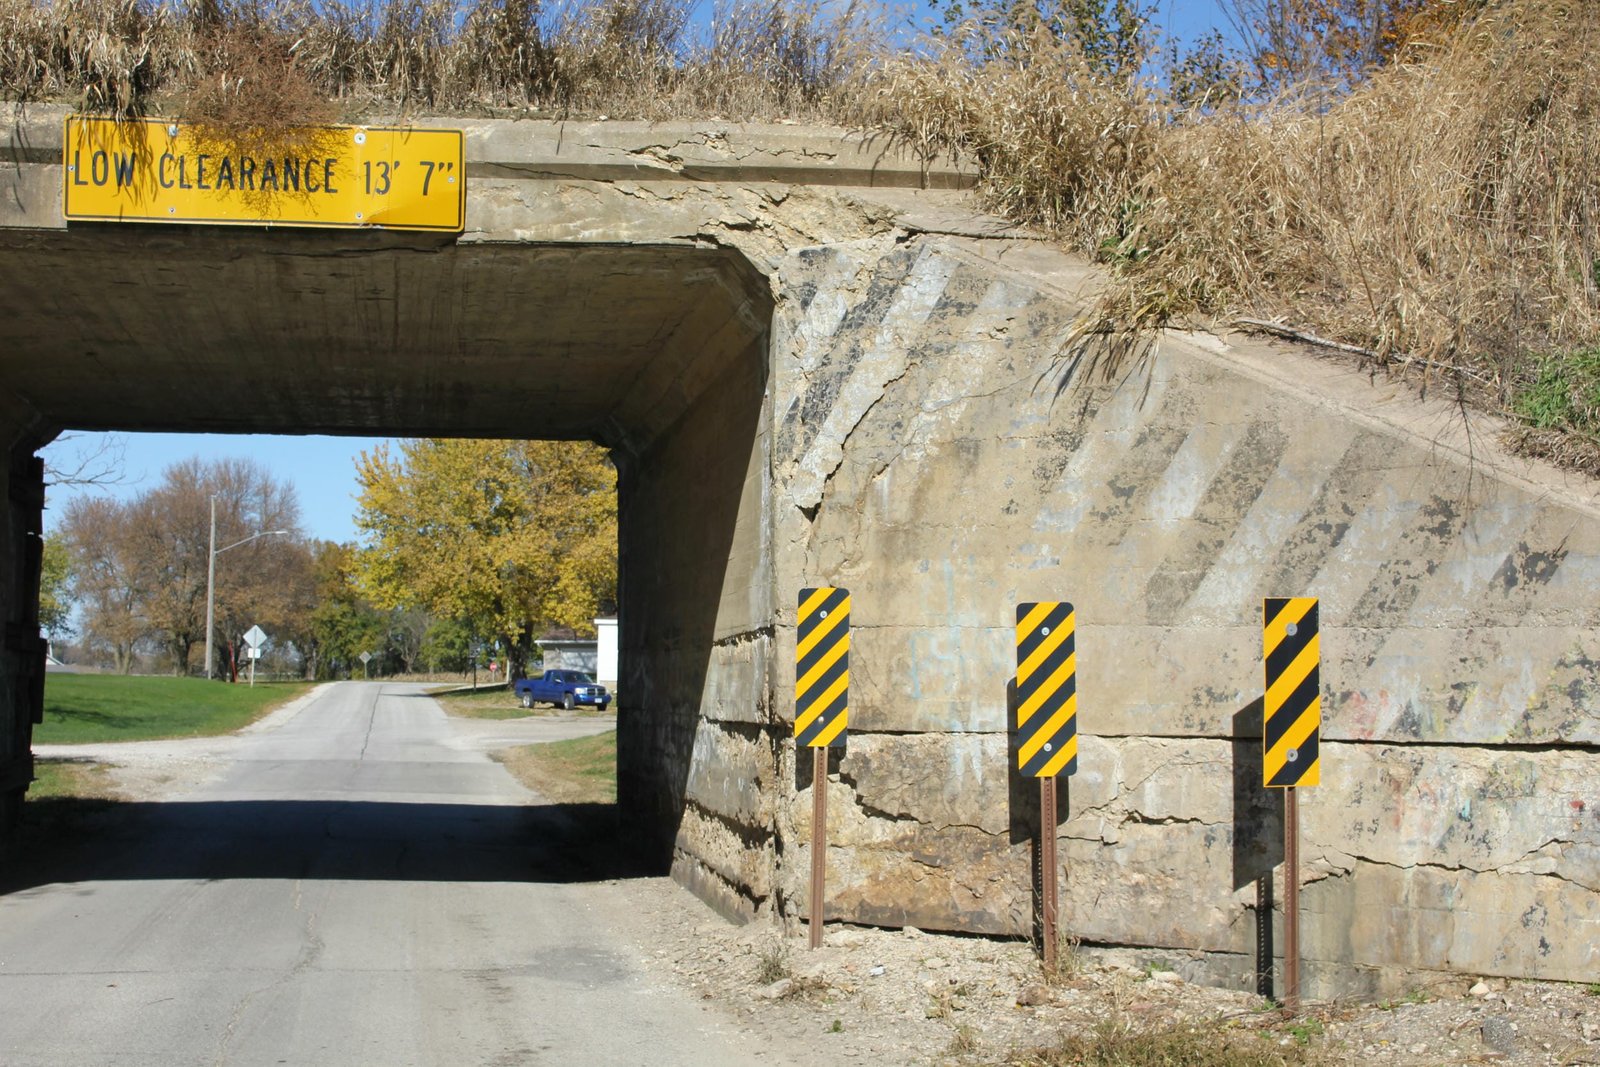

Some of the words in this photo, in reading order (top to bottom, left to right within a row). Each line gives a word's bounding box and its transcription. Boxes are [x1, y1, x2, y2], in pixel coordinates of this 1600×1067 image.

[74, 150, 136, 187] LOW
[159, 152, 338, 194] CLEARANCE
[363, 160, 400, 195] 13'
